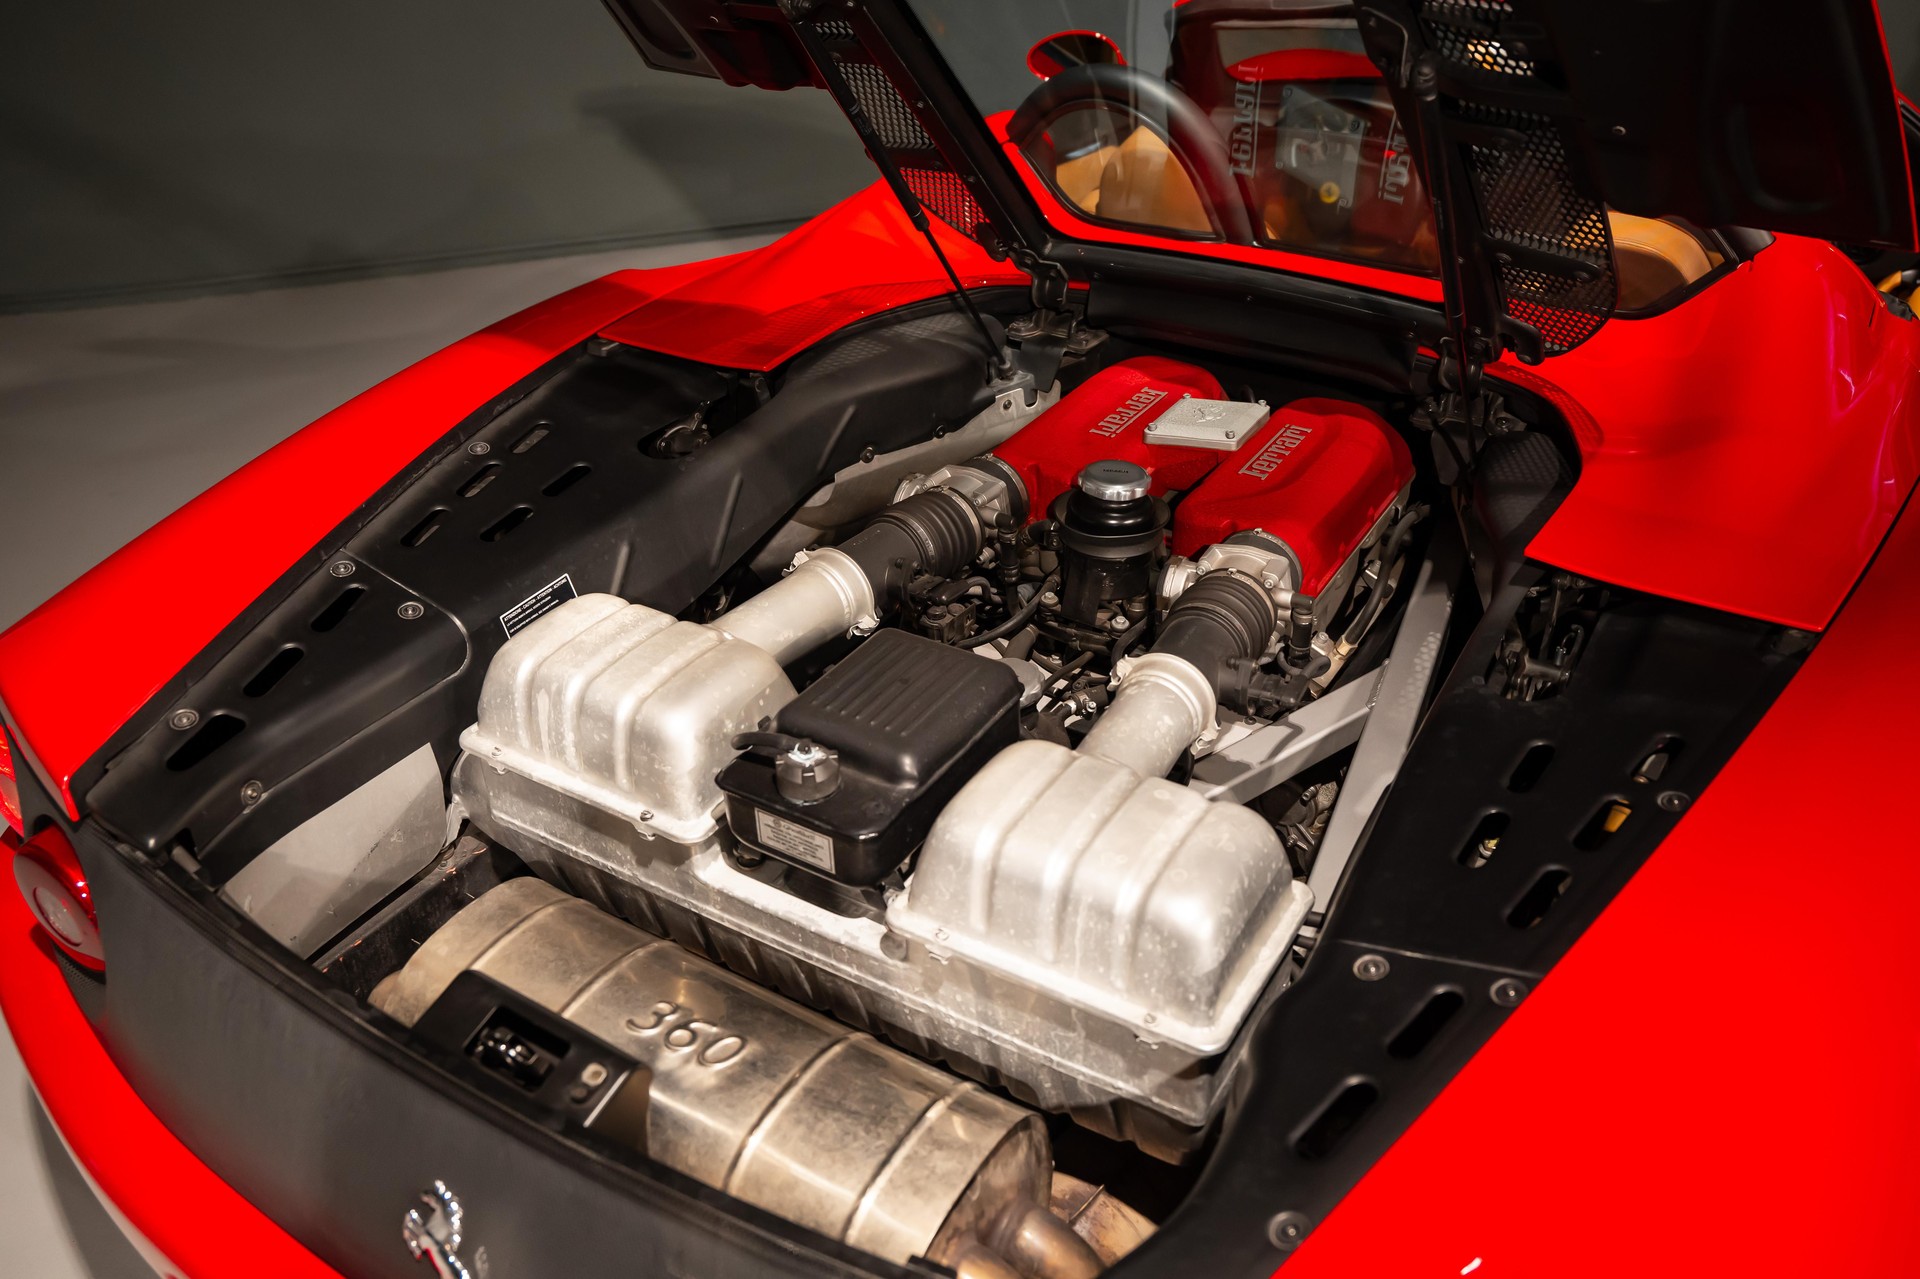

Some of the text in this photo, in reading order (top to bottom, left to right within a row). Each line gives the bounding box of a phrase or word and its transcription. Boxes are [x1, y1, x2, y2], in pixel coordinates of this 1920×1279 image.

[1088, 386, 1169, 439] Ferrari
[1238, 424, 1313, 481] Ferrari
[626, 1000, 749, 1070] 360
